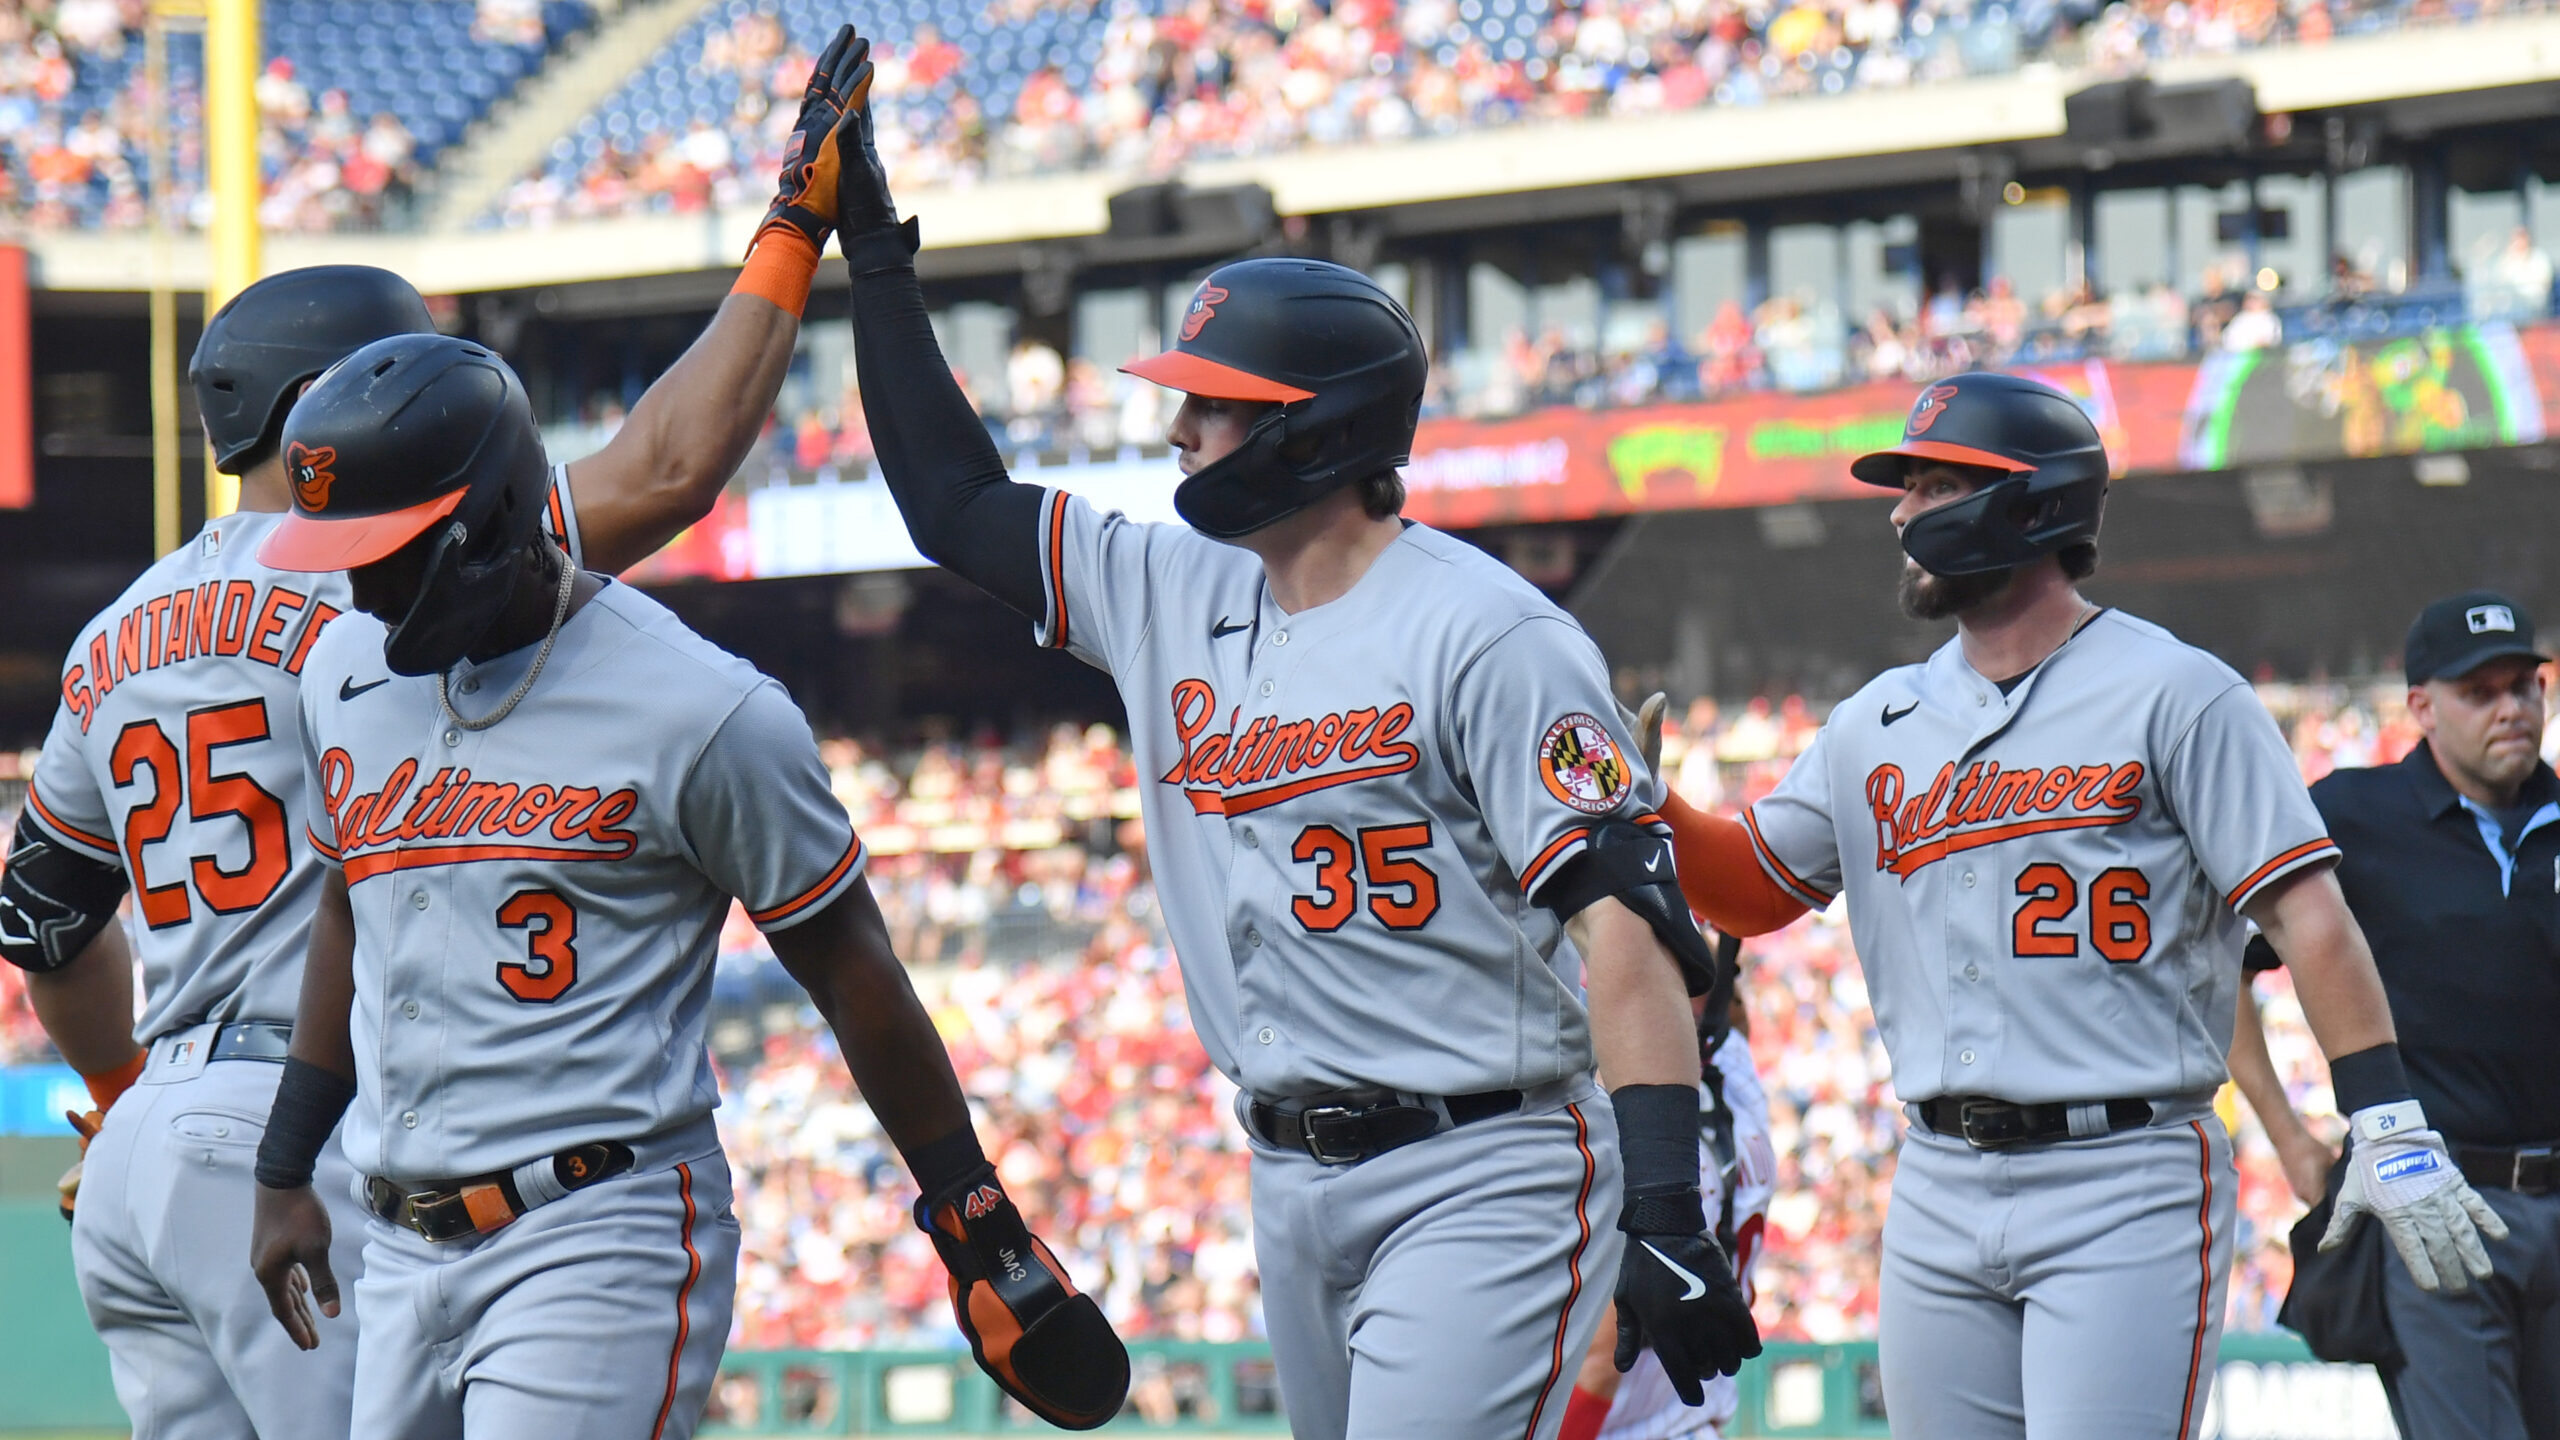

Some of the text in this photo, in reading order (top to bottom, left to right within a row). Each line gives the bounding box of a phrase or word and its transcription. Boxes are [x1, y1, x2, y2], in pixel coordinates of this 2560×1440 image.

[109, 696, 292, 931] 25
[319, 746, 638, 889] Baltimore
[1567, 783, 1628, 812] ORIOLES
[1866, 760, 2145, 888] Baltimore
[1291, 821, 1440, 932] 35
[2012, 863, 2152, 964] 26
[496, 889, 578, 1003] 3
[568, 1155, 588, 1178] 3
[2377, 1113, 2397, 1131] 42
[964, 1184, 1005, 1220] 44
[998, 1247, 1028, 1282] JM3
